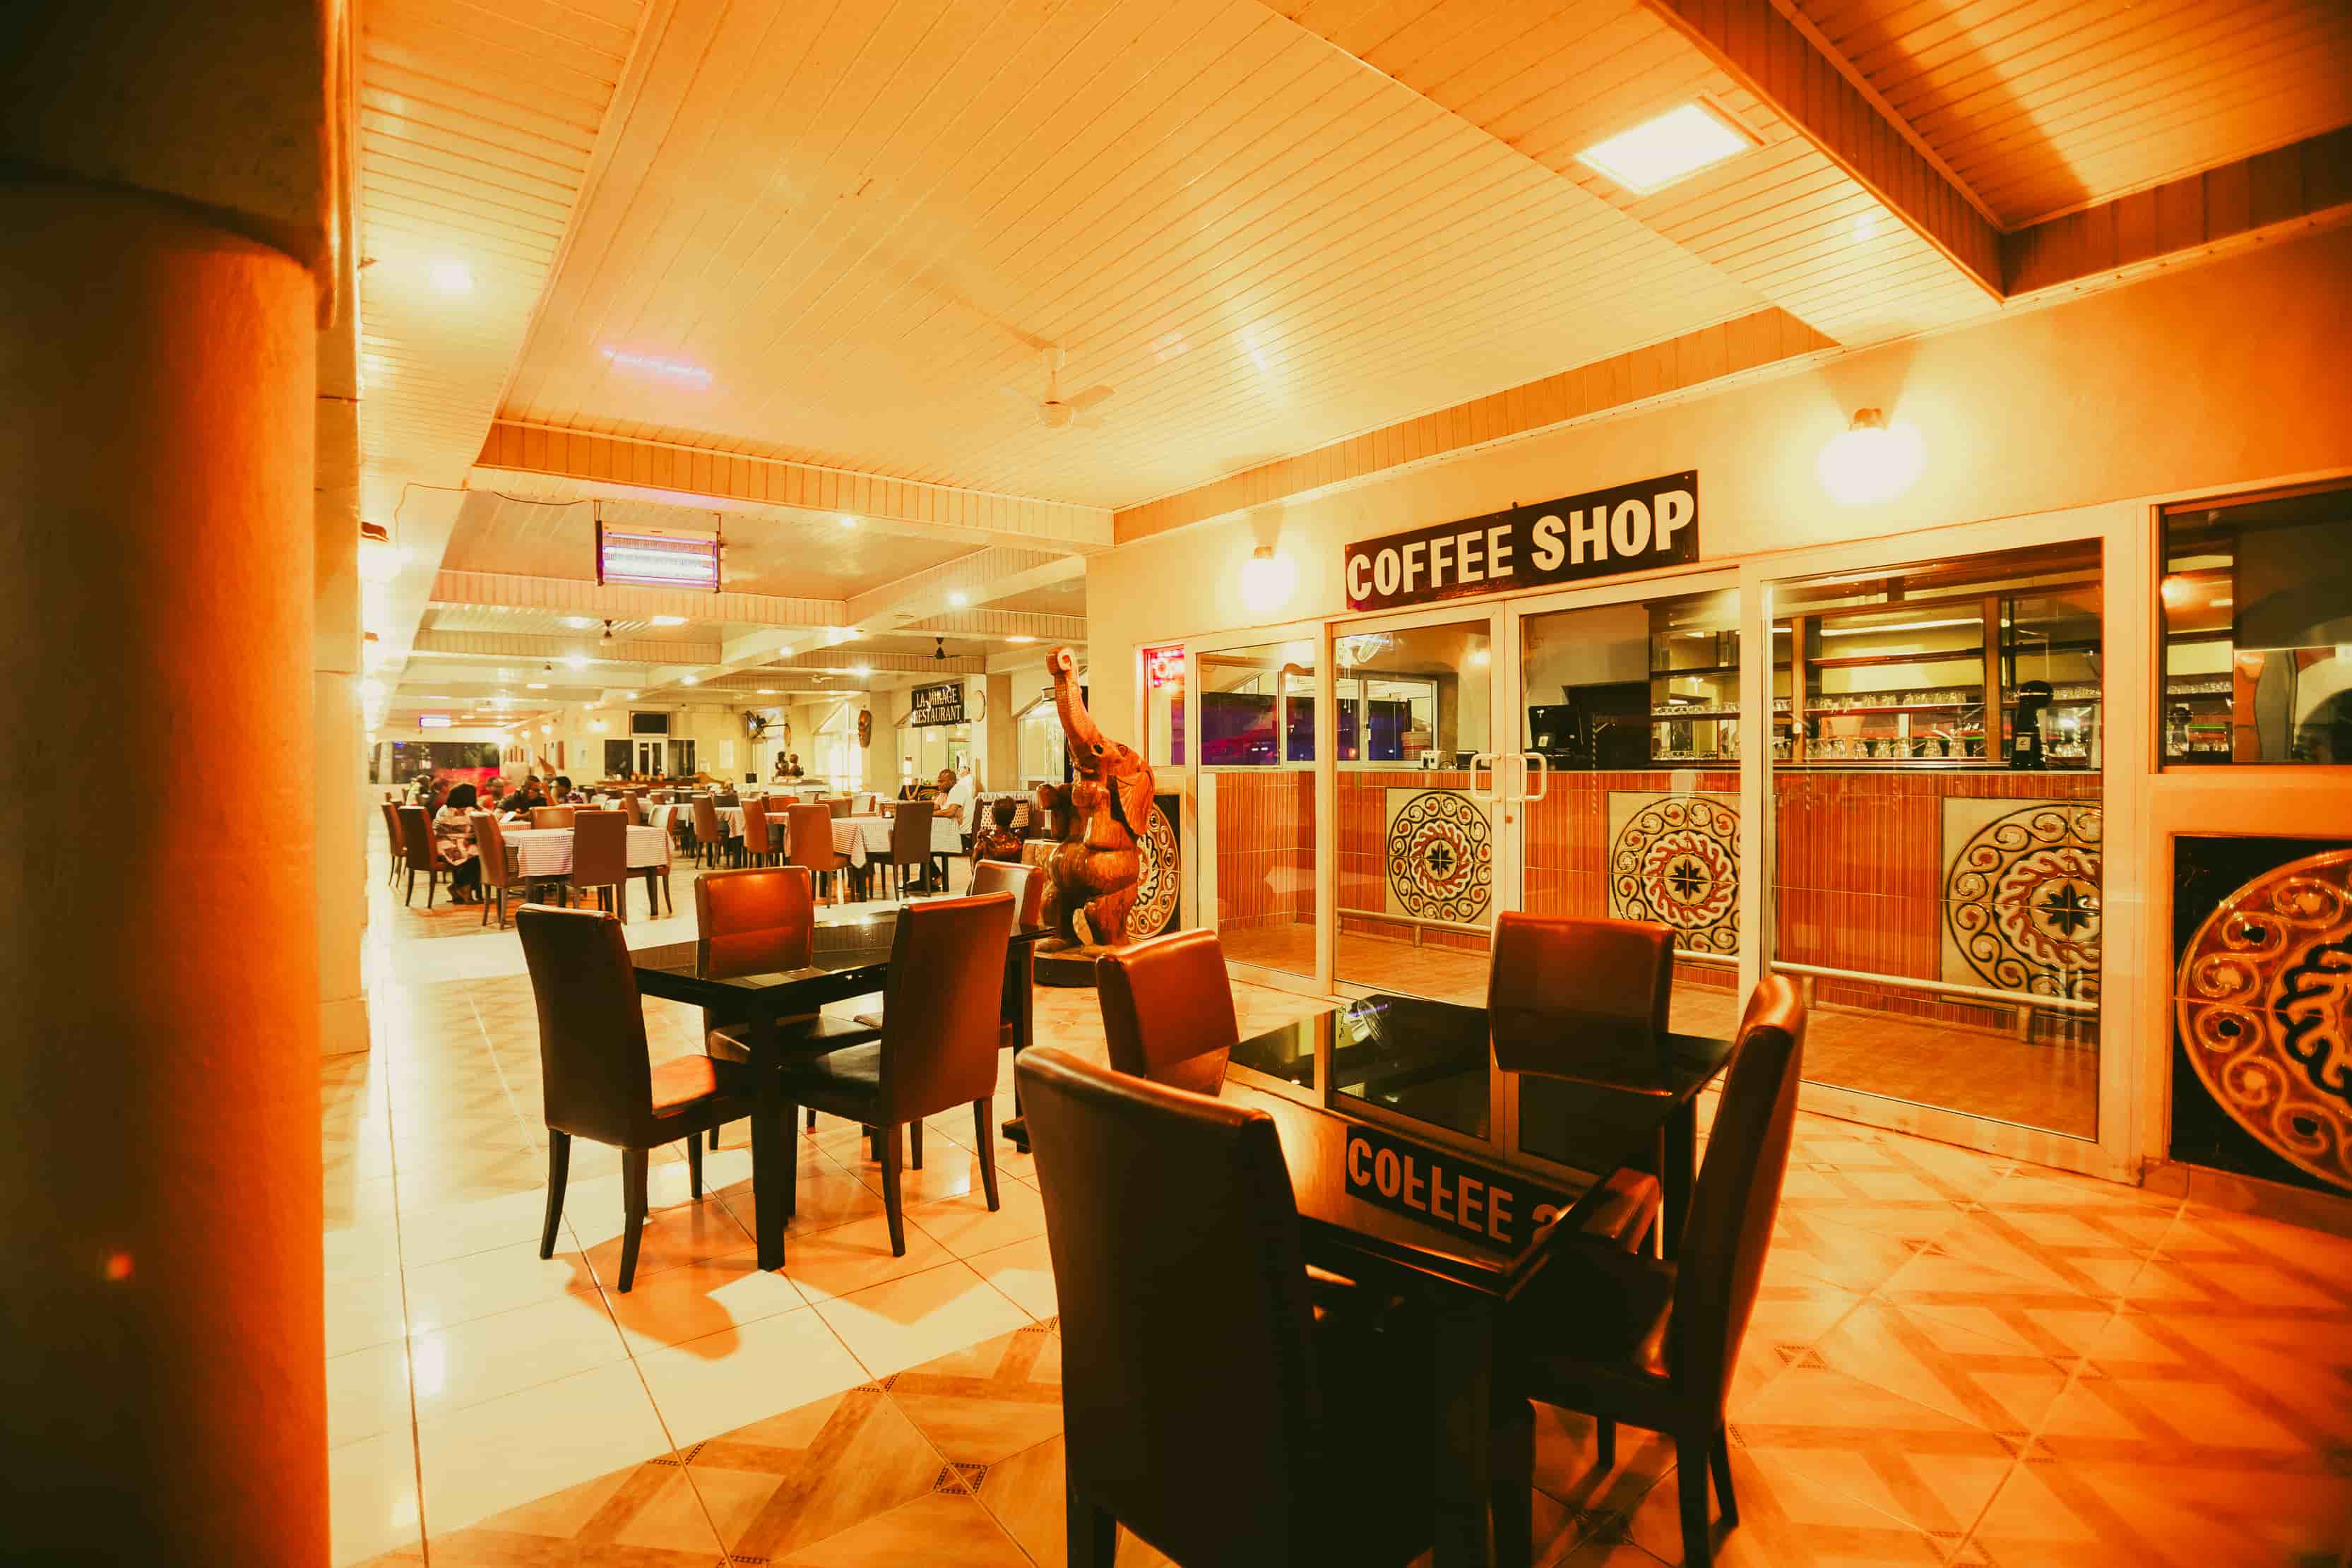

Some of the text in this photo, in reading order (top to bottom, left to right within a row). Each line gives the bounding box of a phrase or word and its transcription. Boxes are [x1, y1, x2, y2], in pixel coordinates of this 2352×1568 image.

[1347, 489, 1694, 600] COFFEE SHOP
[916, 688, 957, 708] LA MIRAGE
[915, 705, 961, 723] RESTAURANT
